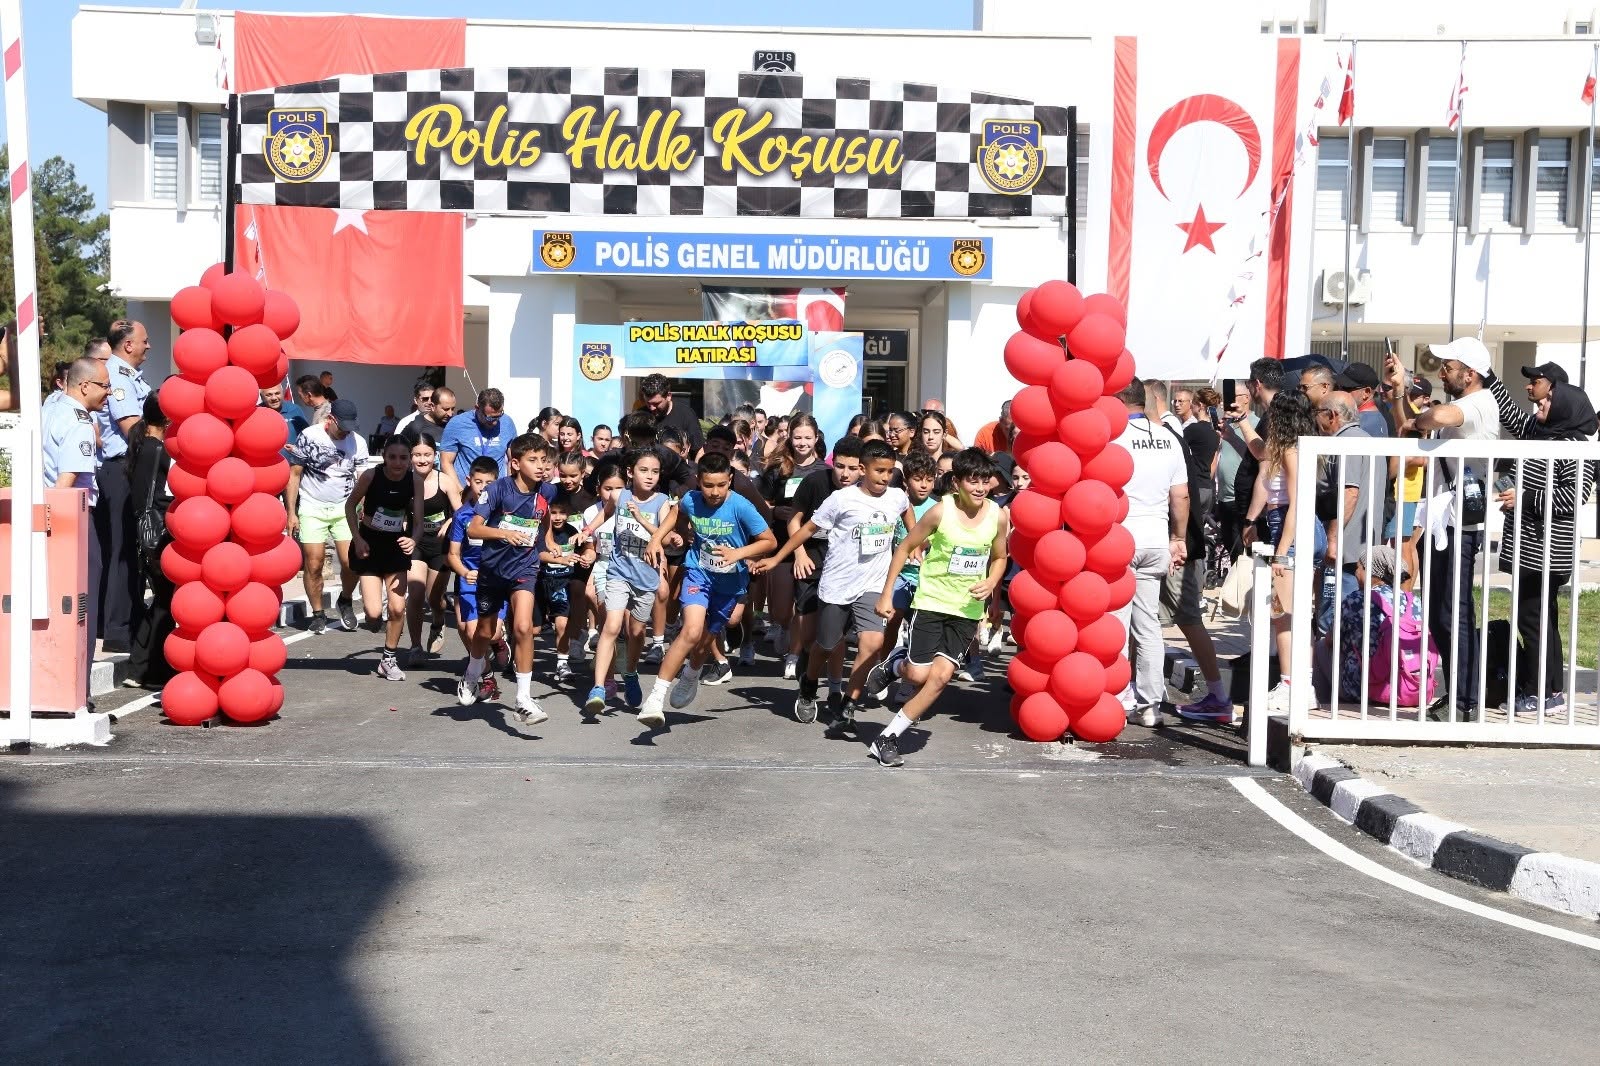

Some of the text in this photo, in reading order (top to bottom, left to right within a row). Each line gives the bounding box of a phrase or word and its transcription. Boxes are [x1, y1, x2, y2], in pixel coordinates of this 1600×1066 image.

[758, 52, 792, 61] POLİS
[278, 112, 317, 122] POLİS
[992, 124, 1031, 135] POLİS
[405, 103, 904, 180] Polis Halk Koşusu
[596, 236, 930, 272] POLİS GENEL MÜDÜRLÜĞÜ
[630, 323, 802, 343] POLİS HALK KOŞUSU
[865, 336, 891, 356] ĞÜ
[676, 346, 757, 364] HATIRASI
[1132, 439, 1171, 450] HAKEM
[626, 522, 640, 532] 012
[874, 539, 885, 547] 021
[963, 560, 978, 569] 044
